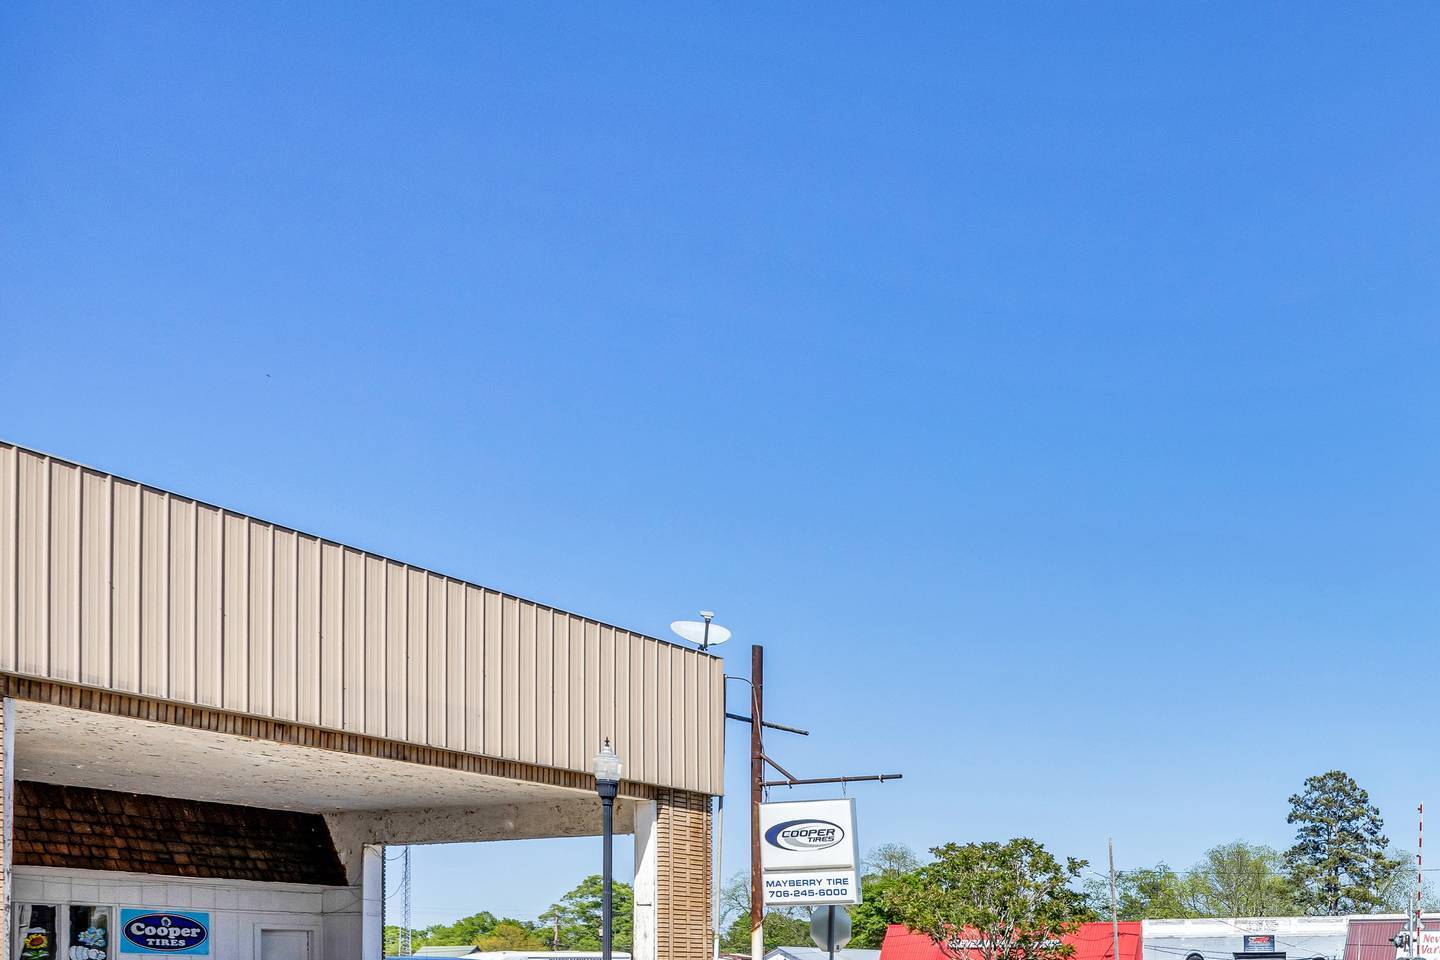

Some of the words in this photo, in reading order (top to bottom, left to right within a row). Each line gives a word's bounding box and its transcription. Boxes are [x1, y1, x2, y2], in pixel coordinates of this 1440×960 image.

[781, 829, 835, 838] COOPER
[766, 878, 823, 888] MAYBERRY
[826, 877, 849, 886] TIRE
[768, 888, 848, 898] 706-245-6000
[130, 922, 201, 940] Cooper
[146, 938, 186, 947] TIRES
